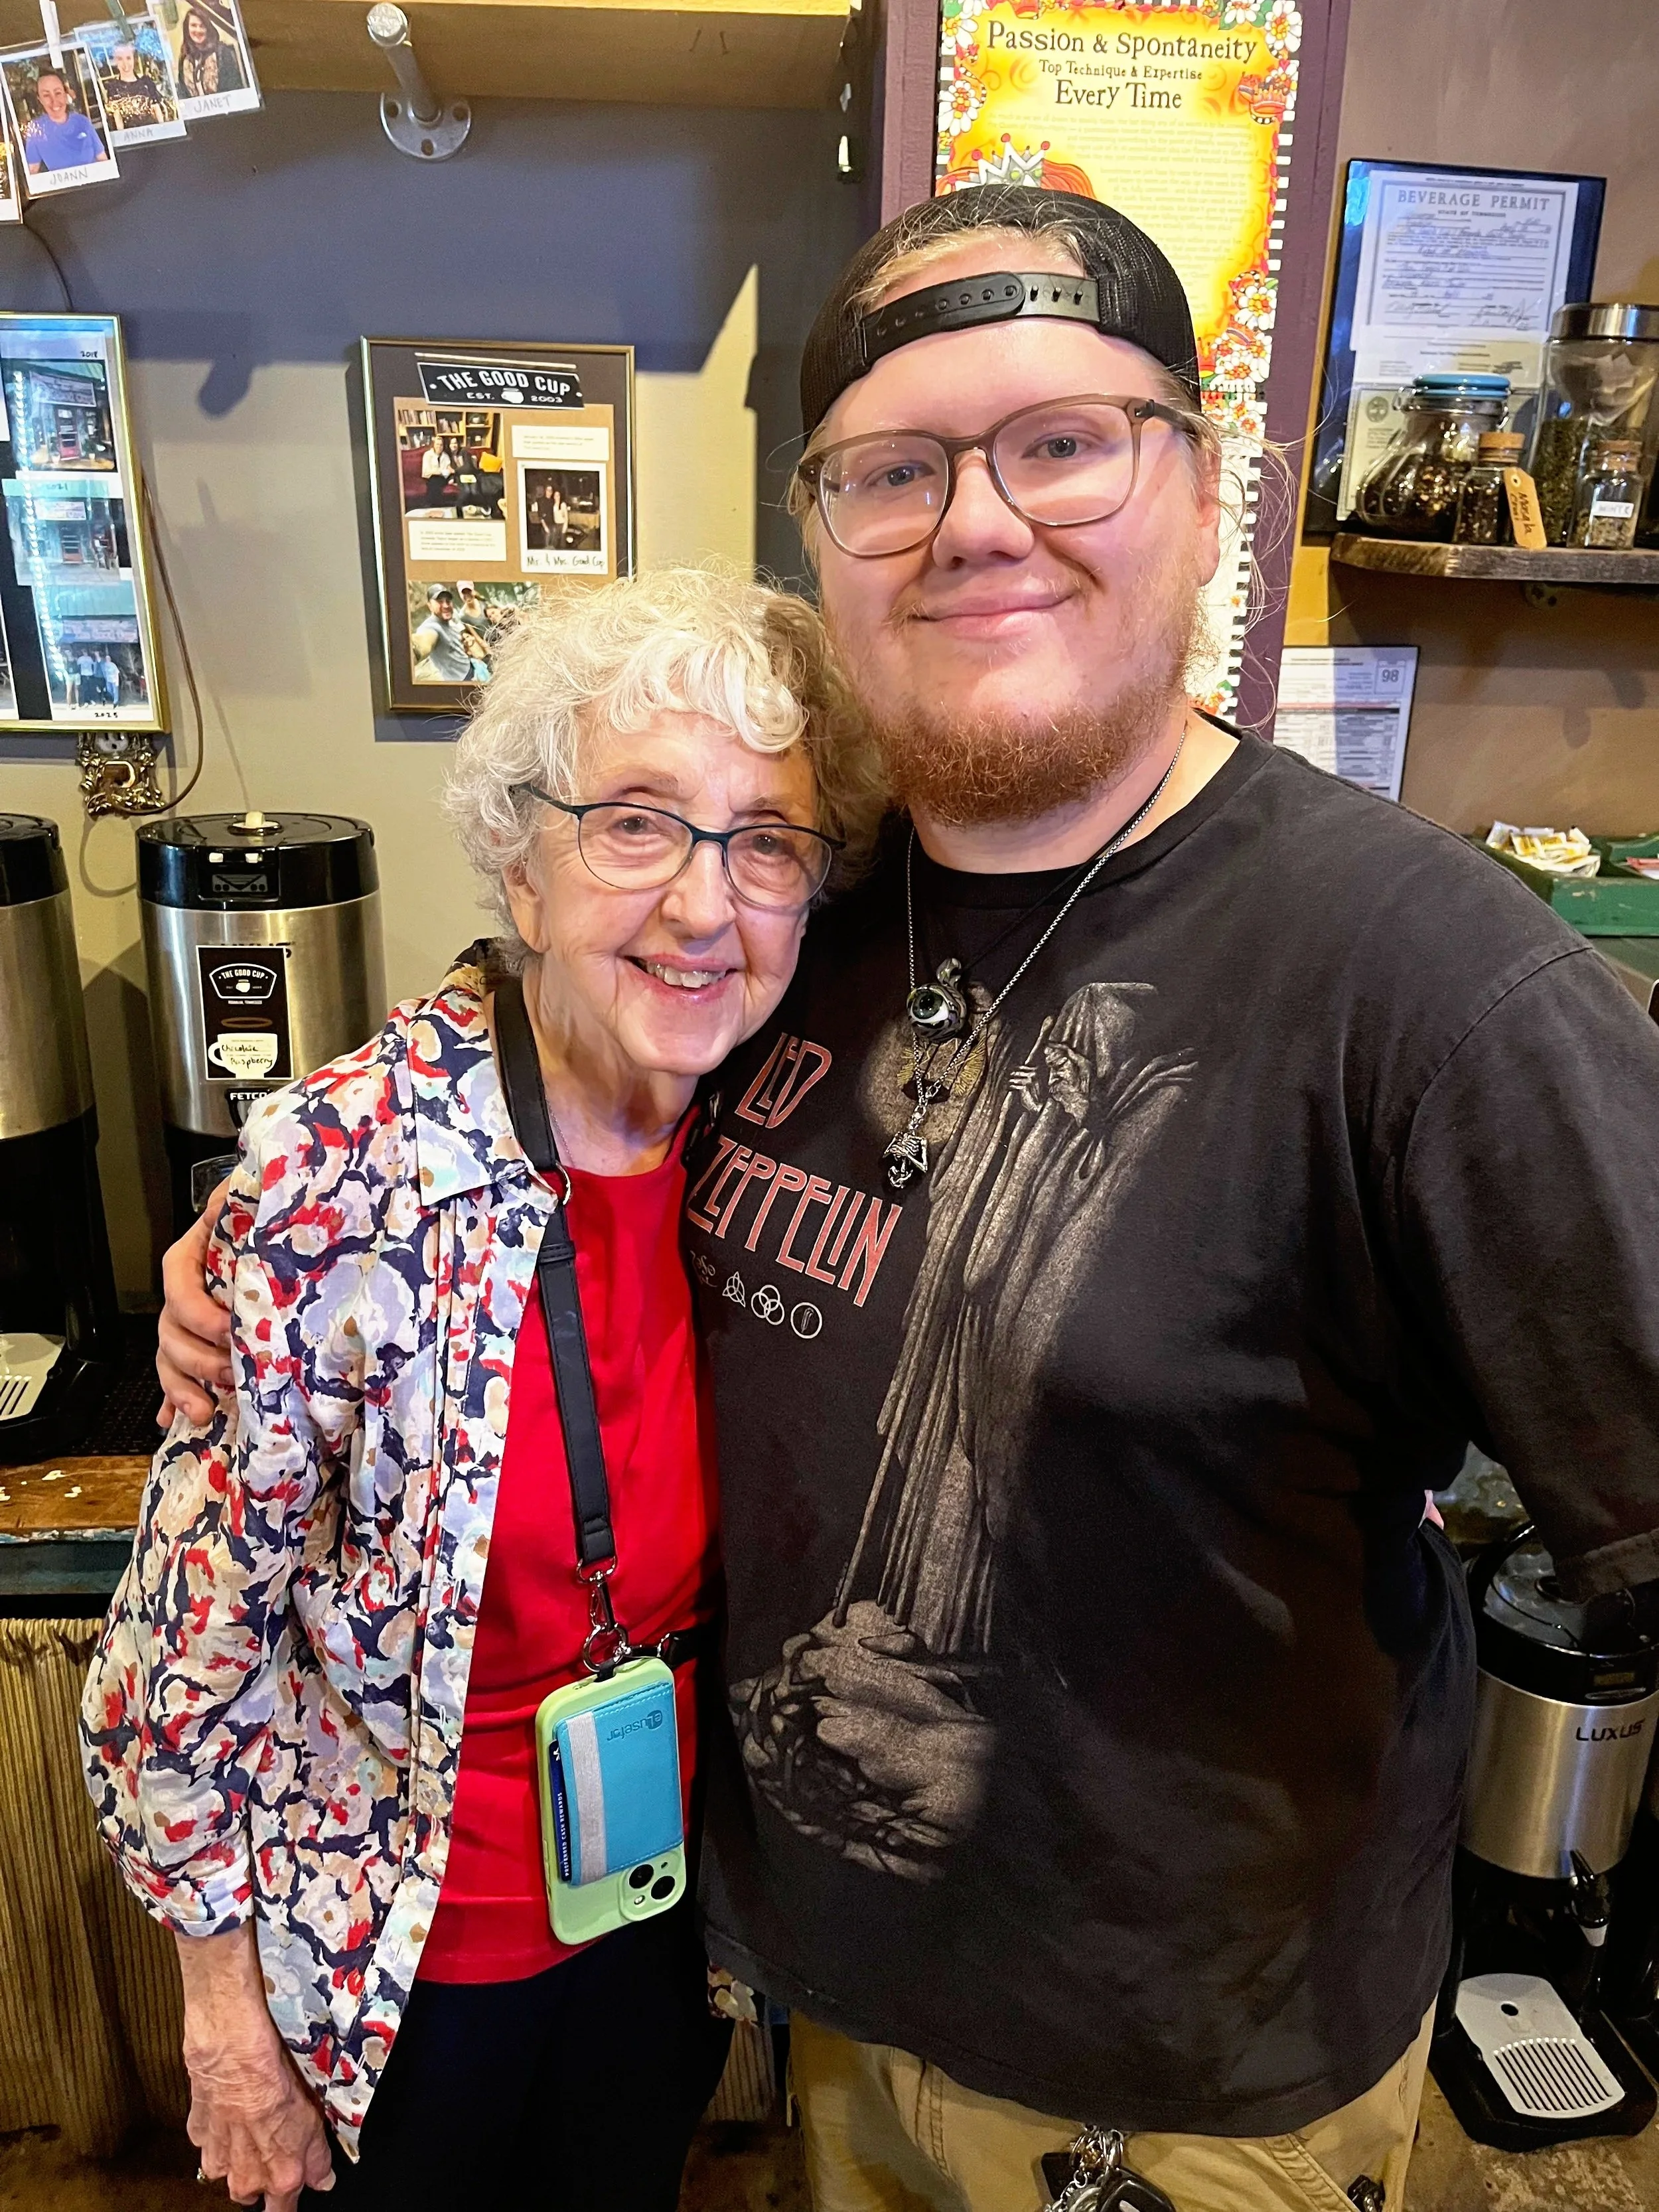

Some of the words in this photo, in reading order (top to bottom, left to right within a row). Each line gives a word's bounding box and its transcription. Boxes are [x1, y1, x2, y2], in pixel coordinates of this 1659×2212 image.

[987, 20, 1084, 53] Passion
[1093, 33, 1108, 54] &
[1116, 32, 1258, 64] Spontaneity
[1039, 59, 1062, 76] Top
[1066, 60, 1126, 79] Technique
[1131, 67, 1138, 78] &
[1143, 65, 1202, 80] Expertise
[193, 94, 232, 113] JANET
[1054, 79, 1120, 110] Every
[1125, 82, 1183, 109] Time
[123, 128, 154, 142] ANNA
[50, 167, 88, 186] JOANN
[1398, 190, 1481, 207] BEVERAGE
[1490, 195, 1550, 211] PERMIT
[437, 372, 478, 391] THE
[478, 370, 530, 388] GOOD
[534, 376, 571, 396] CUP
[467, 392, 495, 400] EST.
[531, 395, 563, 404] 2003
[1382, 669, 1400, 683] 98
[221, 970, 234, 980] THE
[252, 970, 265, 979] CUP
[735, 1032, 832, 1129] LED
[687, 1135, 903, 1307] ZEPPELIN
[1575, 1718, 1646, 1741] LUXUS
